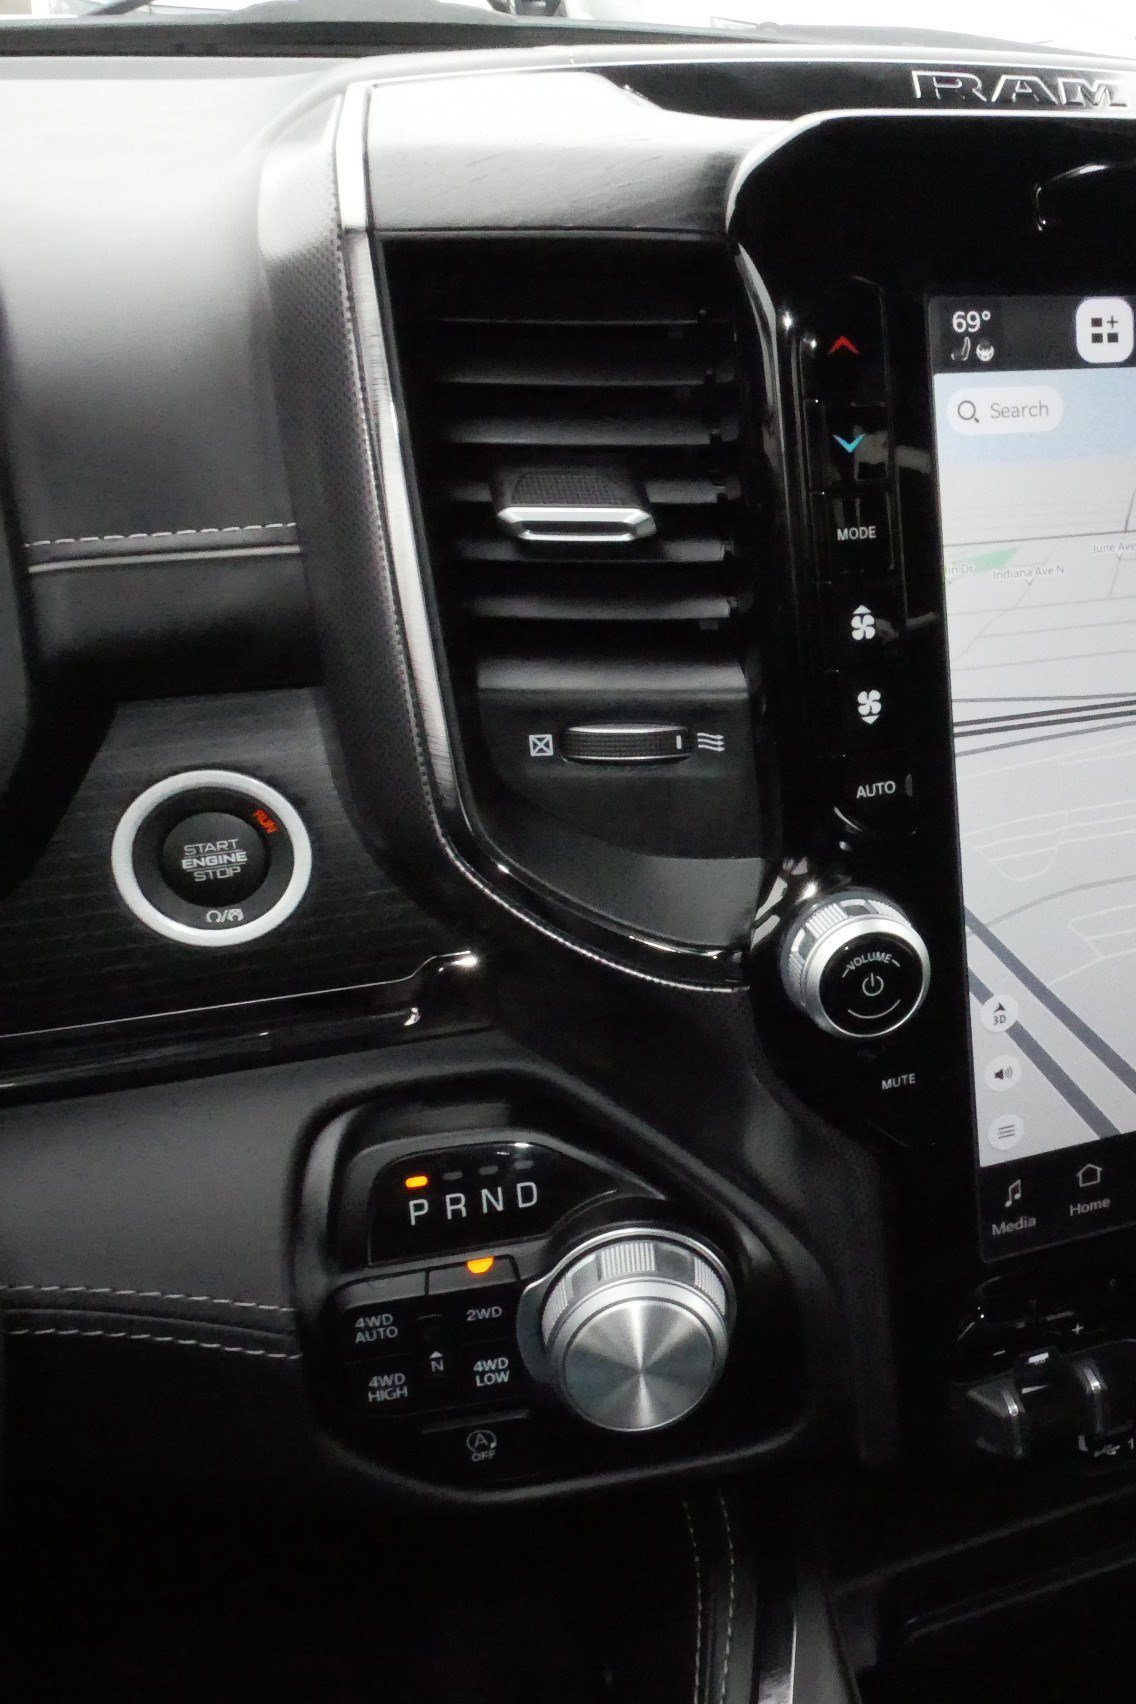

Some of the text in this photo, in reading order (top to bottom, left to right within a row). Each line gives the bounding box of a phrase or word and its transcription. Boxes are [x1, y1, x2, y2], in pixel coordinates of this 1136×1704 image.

[911, 70, 1129, 108] RAM
[952, 310, 991, 333] 69°
[990, 400, 1049, 419] Search
[837, 526, 877, 541] MODE
[1093, 543, 1115, 554] June
[1117, 541, 1136, 552] Ave
[993, 564, 1065, 580] Indiana Ave N
[856, 780, 896, 798] AUTO
[253, 809, 278, 834] RUN
[183, 838, 239, 856] START
[181, 851, 248, 870] ENGINE
[194, 865, 242, 881] STOP
[846, 951, 893, 971] VOLUME
[992, 1014, 1007, 1026] 3D
[881, 1073, 917, 1090] MUTE
[408, 1181, 538, 1226] P R N D
[1069, 1197, 1112, 1217] Home
[991, 1215, 1037, 1236] Media
[354, 1313, 394, 1329] 4WD
[466, 1306, 503, 1322] 2WD
[355, 1326, 399, 1344] AUTO
[430, 1359, 445, 1373] N
[473, 1357, 510, 1372] 4WD
[368, 1372, 407, 1388] 4WD
[475, 1369, 511, 1387] LOW
[367, 1385, 409, 1403] HIGH
[471, 1451, 496, 1462] OFF
